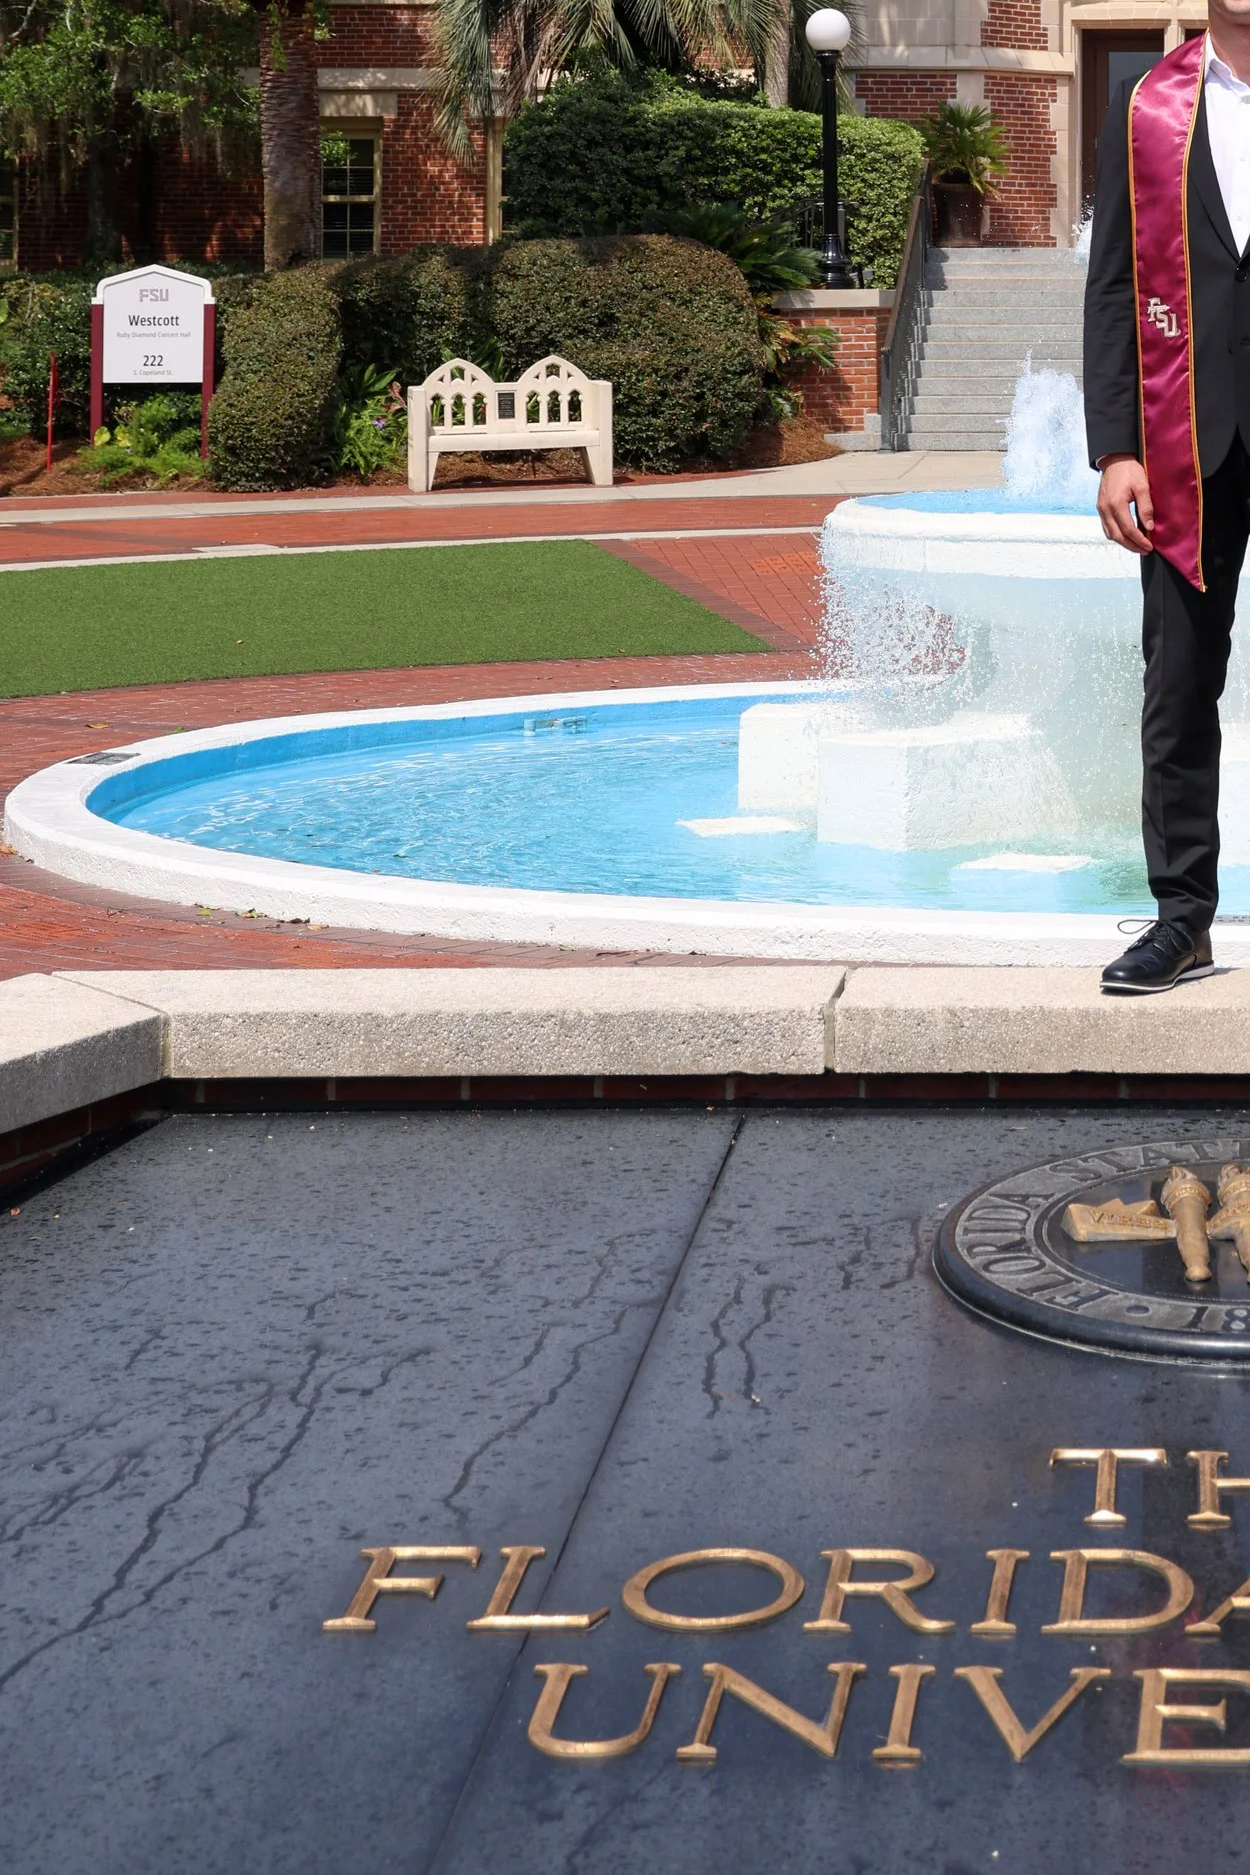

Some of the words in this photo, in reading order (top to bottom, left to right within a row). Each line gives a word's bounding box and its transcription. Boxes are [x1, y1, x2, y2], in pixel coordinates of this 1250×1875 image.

[139, 288, 169, 302] FSU
[128, 314, 180, 327] Westcott
[1147, 297, 1182, 337] FSU
[116, 331, 130, 339] Ruby
[143, 354, 164, 367] 222
[139, 369, 165, 377] Copeland
[962, 1192, 1119, 1313] FLORIDA
